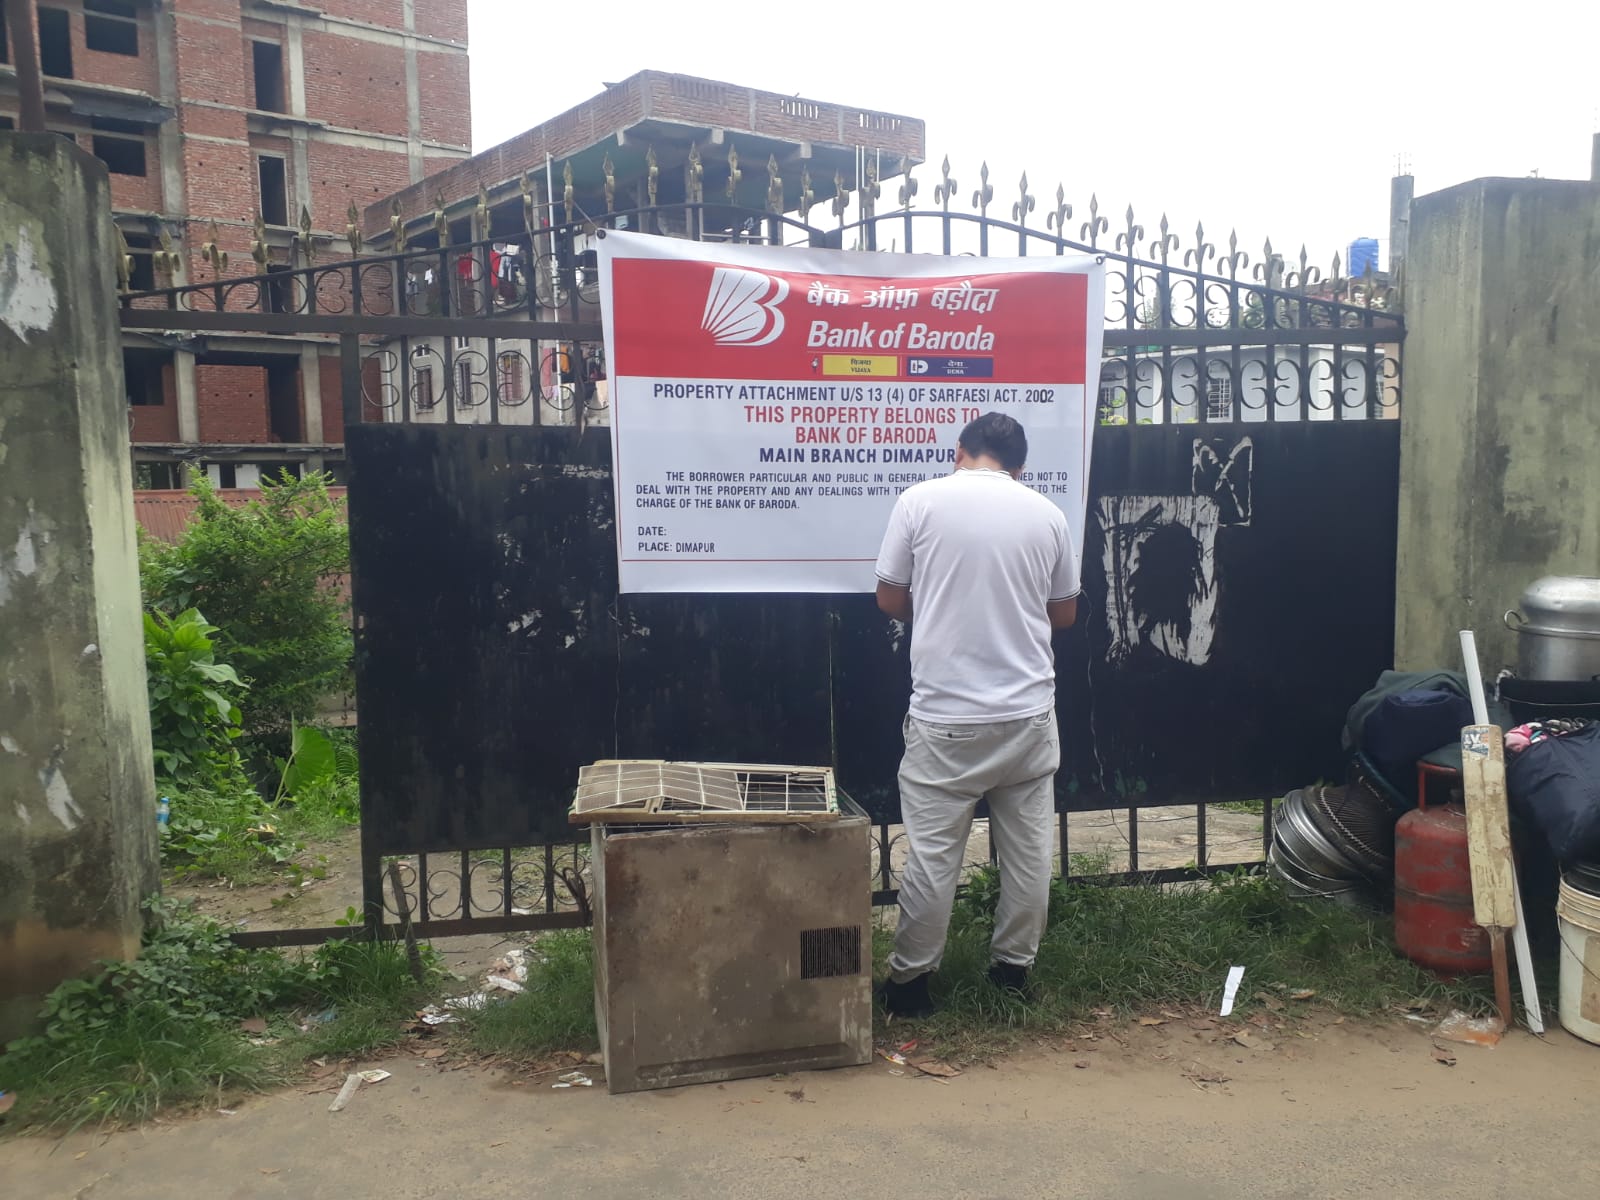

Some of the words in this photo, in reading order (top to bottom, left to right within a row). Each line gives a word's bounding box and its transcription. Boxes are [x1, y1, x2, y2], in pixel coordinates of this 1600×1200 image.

[807, 321, 875, 347] Bank
[878, 322, 906, 348] of
[907, 323, 995, 350] Baroda
[653, 383, 734, 399] PROPERTY
[739, 385, 836, 401] ATTACHMENT
[841, 387, 863, 403] U/S
[868, 388, 882, 401] 13
[887, 388, 904, 405] (4)
[909, 389, 925, 402] OF
[929, 389, 990, 402] SARFAESI
[994, 390, 1021, 403] ACT.
[1025, 390, 1055, 403] 2002
[744, 406, 784, 423] THIS
[791, 406, 879, 424] PROPERTY
[884, 408, 956, 424] BELONGS
[961, 408, 980, 423] TO
[796, 427, 840, 443] BANK
[846, 427, 867, 444] OF
[873, 427, 937, 444] BARODA
[760, 448, 805, 462] MAIN
[811, 448, 876, 463] BRANCH
[882, 449, 956, 463] DIMAPUR
[666, 472, 684, 481] THE
[689, 472, 745, 482] BORROWER
[750, 473, 807, 483] PARTICULAR
[812, 473, 831, 483] AND
[836, 473, 868, 483] PUBLIC
[874, 474, 883, 482] IN
[888, 473, 927, 483] GENERAL
[1038, 472, 1053, 480] NOT
[1057, 472, 1068, 480] TO
[636, 485, 660, 495] DEAL
[665, 485, 690, 495] WITH
[695, 486, 712, 495] THE
[717, 486, 767, 495] PROPERTY
[771, 486, 790, 496] AND
[795, 487, 813, 496] ANY
[818, 487, 863, 496] DEALINGS
[867, 487, 890, 496] WITH
[895, 486, 910, 495] TH
[1038, 485, 1048, 493] TO
[1051, 485, 1067, 493] THE
[636, 499, 676, 508] CHARGE
[679, 499, 692, 508] OF
[695, 499, 712, 508] THE
[716, 499, 741, 509] BANK
[744, 500, 756, 509] OF
[759, 500, 800, 509] BARODA.
[638, 527, 666, 536] DATE:
[638, 542, 672, 551] PLACE:
[676, 543, 715, 552] DIMAPUR
